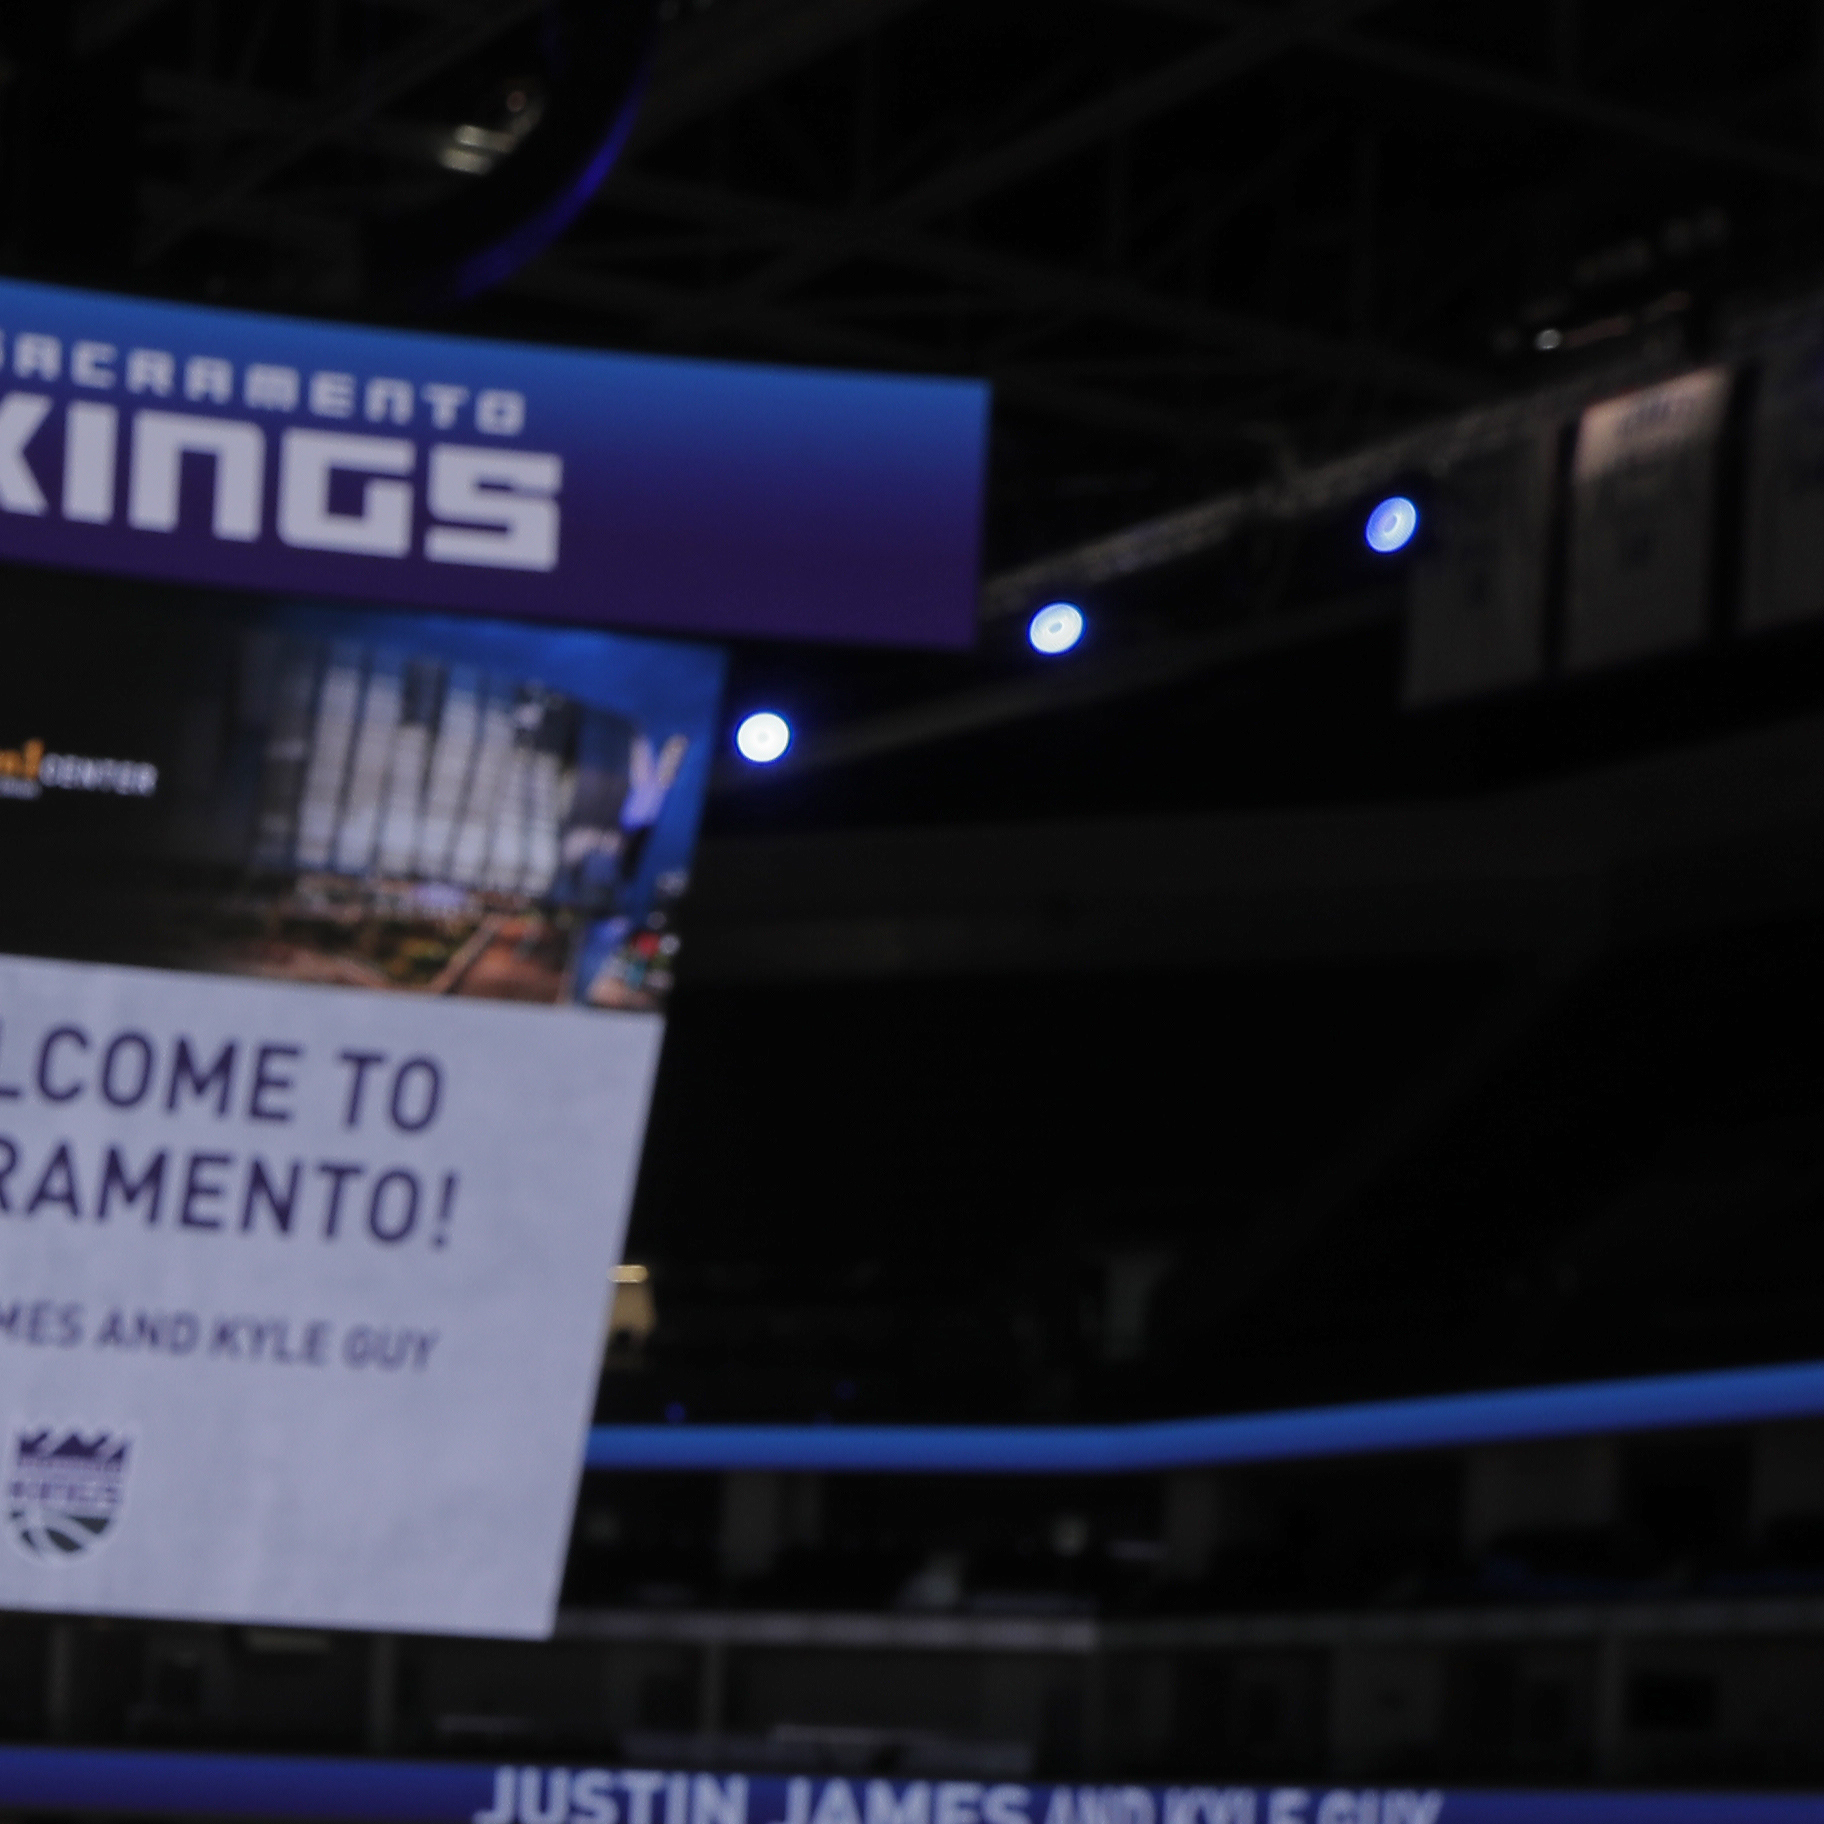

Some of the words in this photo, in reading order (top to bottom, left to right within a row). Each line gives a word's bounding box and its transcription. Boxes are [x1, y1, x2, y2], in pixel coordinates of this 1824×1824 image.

[338, 1050, 443, 1136] TO
[95, 1304, 199, 1358] AND
[208, 1313, 329, 1370] KYLE
[342, 1323, 442, 1374] GUY
